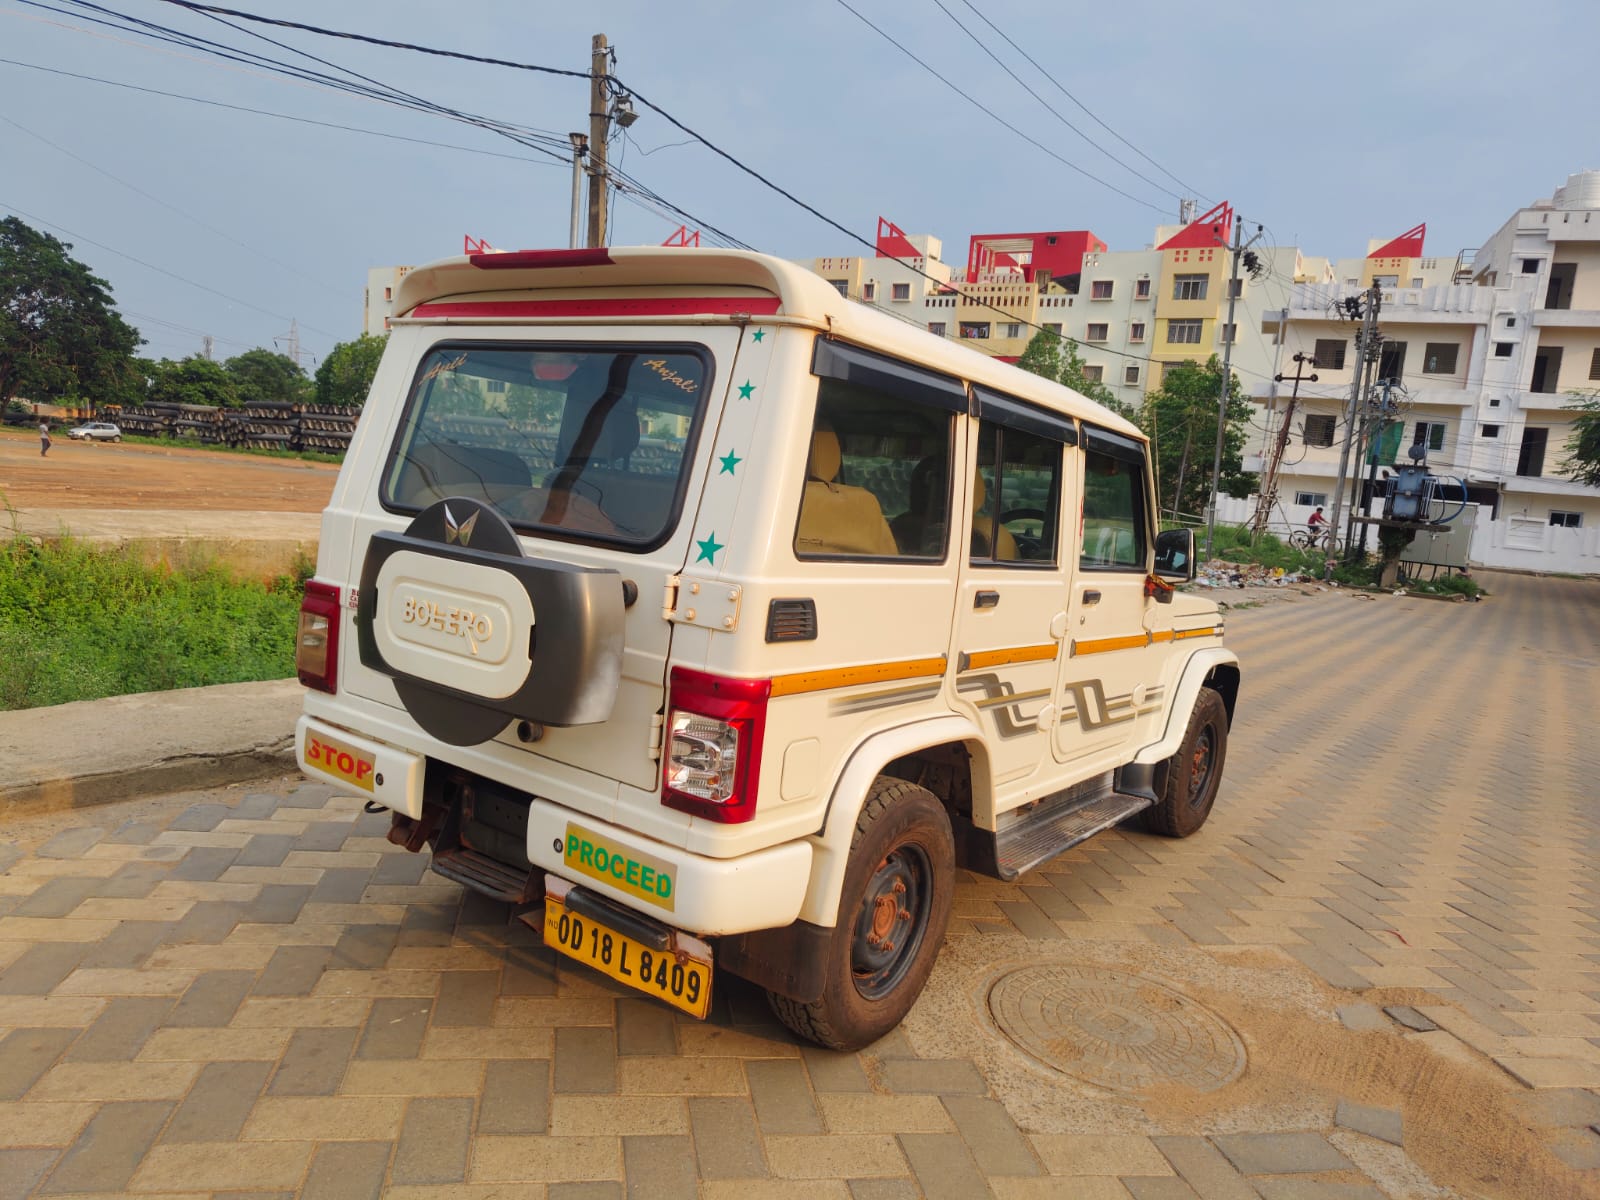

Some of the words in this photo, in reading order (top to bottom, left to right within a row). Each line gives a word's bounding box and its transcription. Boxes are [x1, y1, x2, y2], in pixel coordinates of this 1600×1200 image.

[642, 360, 698, 393] Anjali
[403, 597, 492, 655] BOLERO
[308, 738, 372, 780] STOP
[567, 834, 672, 898] PROCEED
[591, 928, 613, 965] 18
[619, 941, 632, 976] L
[640, 951, 700, 1004] 8409
